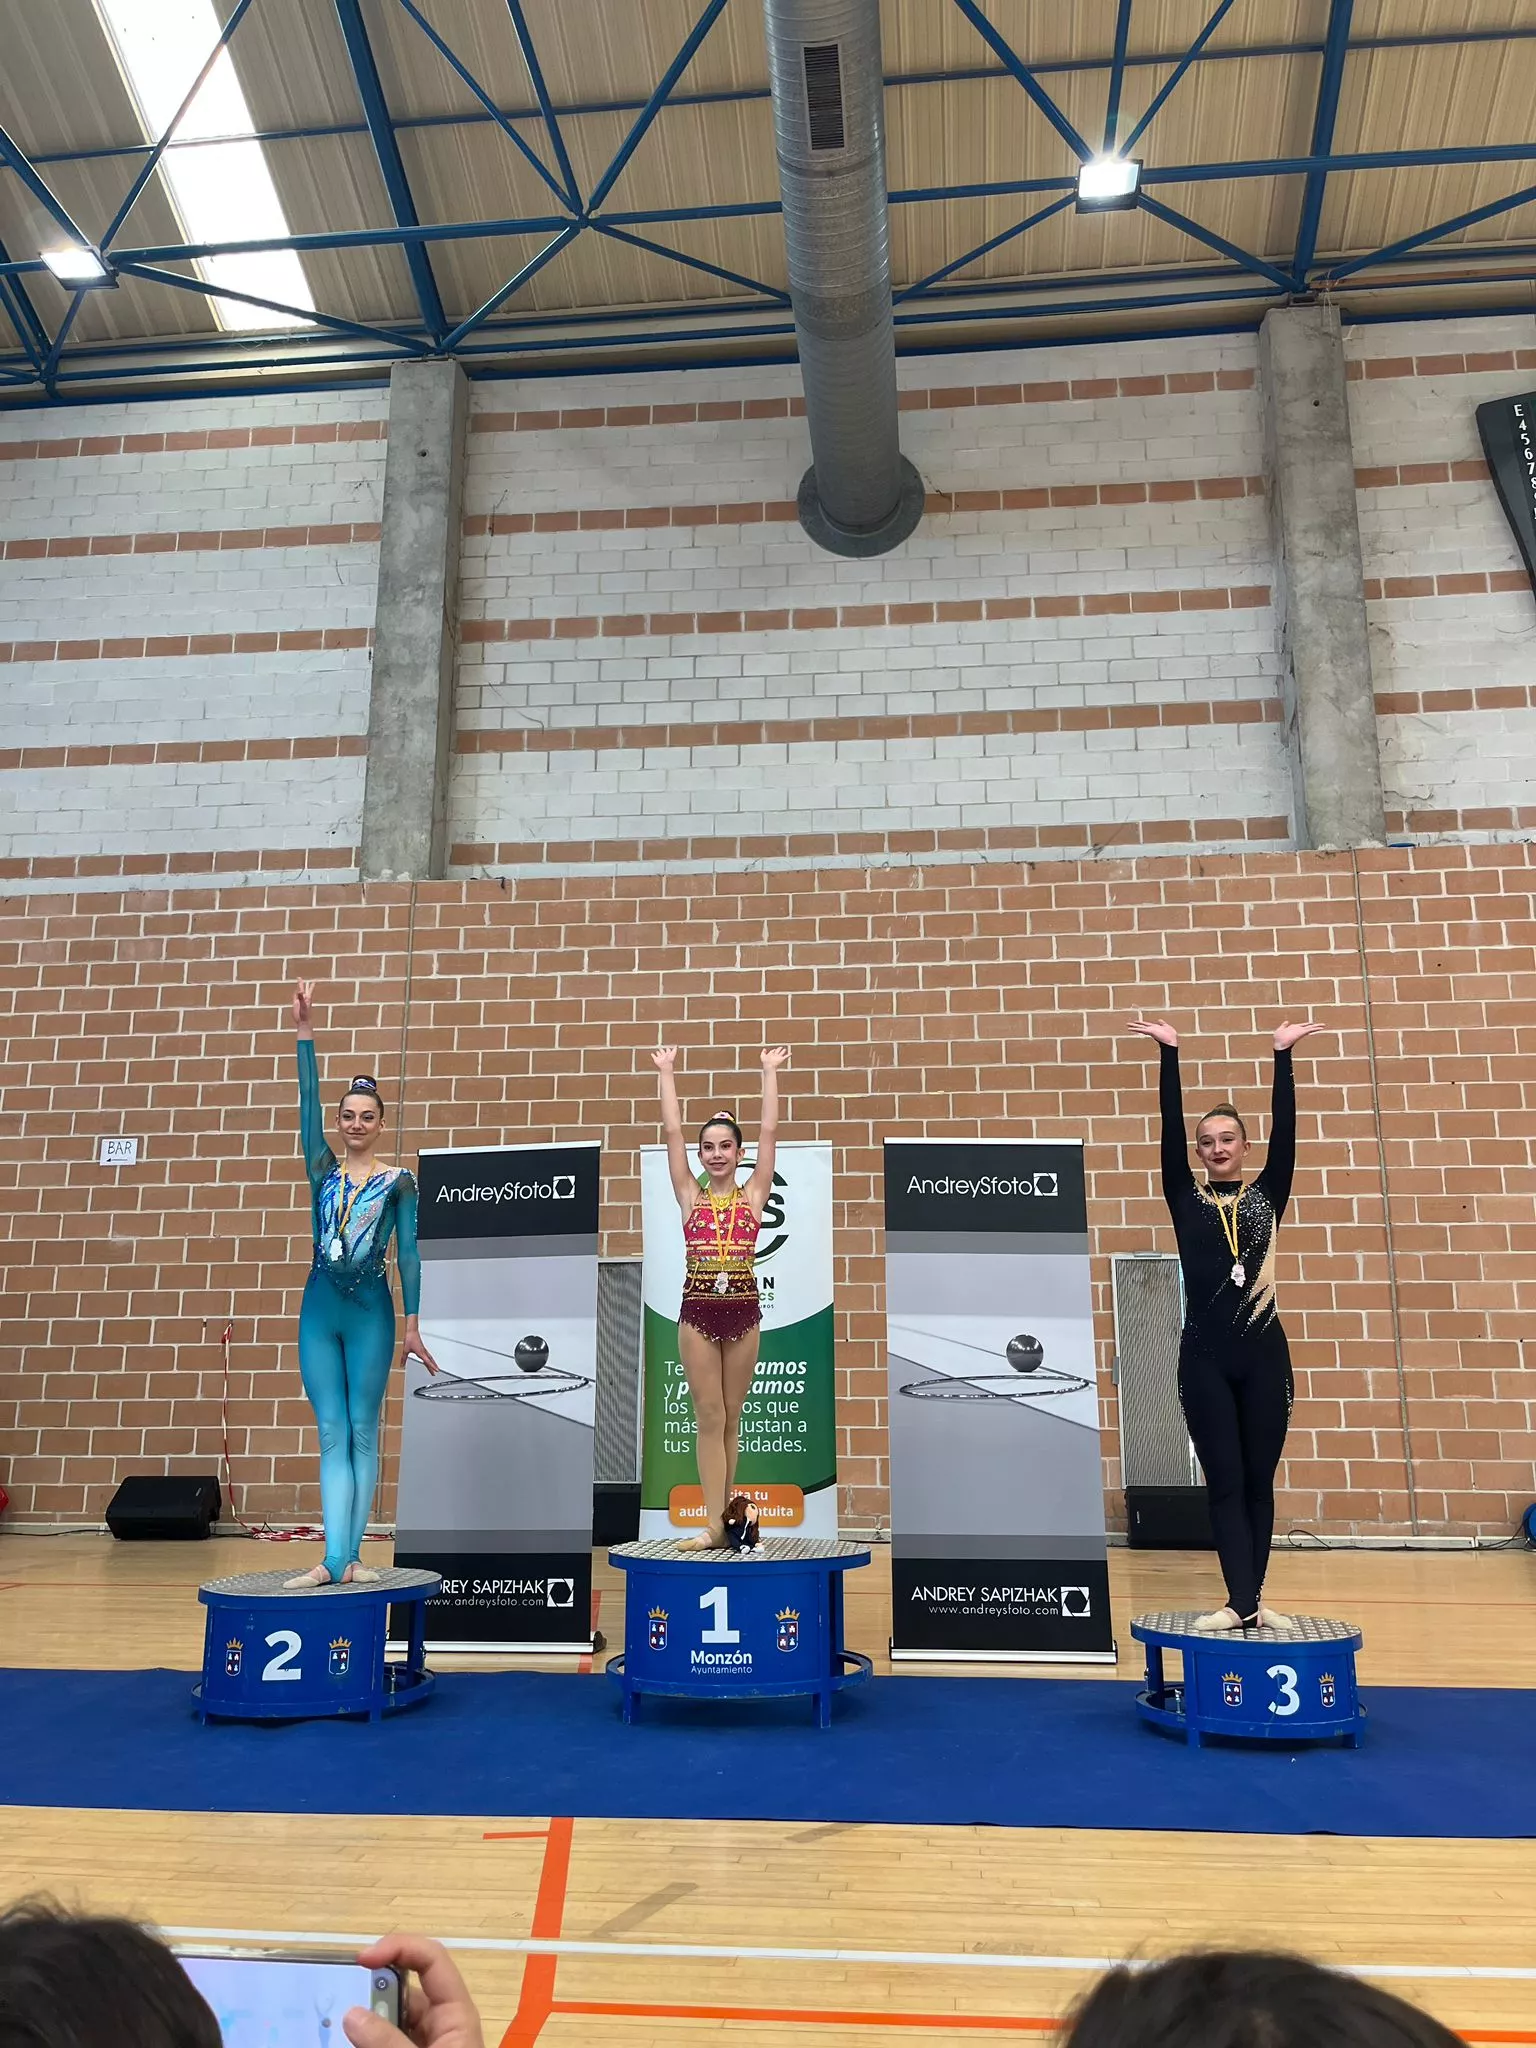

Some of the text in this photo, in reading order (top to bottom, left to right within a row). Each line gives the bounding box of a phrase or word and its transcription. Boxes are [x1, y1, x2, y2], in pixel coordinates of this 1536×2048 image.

[1514, 404, 1524, 416] E
[1518, 418, 1527, 431] 4
[1520, 432, 1531, 446] 5
[1524, 447, 1534, 460] 6
[1526, 461, 1536, 475] 7
[107, 1141, 132, 1155] BAR
[435, 1181, 552, 1204] AndreySfoto
[906, 1175, 1033, 1199] AndreySfoto
[664, 1360, 685, 1376] Te
[663, 1383, 674, 1400] y
[664, 1398, 689, 1415] los
[766, 1401, 800, 1418] que
[664, 1417, 808, 1438] más justan a
[664, 1435, 808, 1453] tus sidades.
[754, 1490, 769, 1501] tu
[440, 1579, 545, 1595] REY SAPIZHAK
[911, 1586, 1059, 1603] ANDREY SAPIZHAK
[424, 1595, 544, 1609] www.andreysfoto.com
[928, 1603, 1059, 1617] www.andreysfoto.com
[699, 1586, 740, 1644] 1
[262, 1630, 302, 1681] 2
[690, 1649, 753, 1666] Monzón
[690, 1665, 753, 1676] Ayuntamiento
[1265, 1664, 1301, 1716] 3
